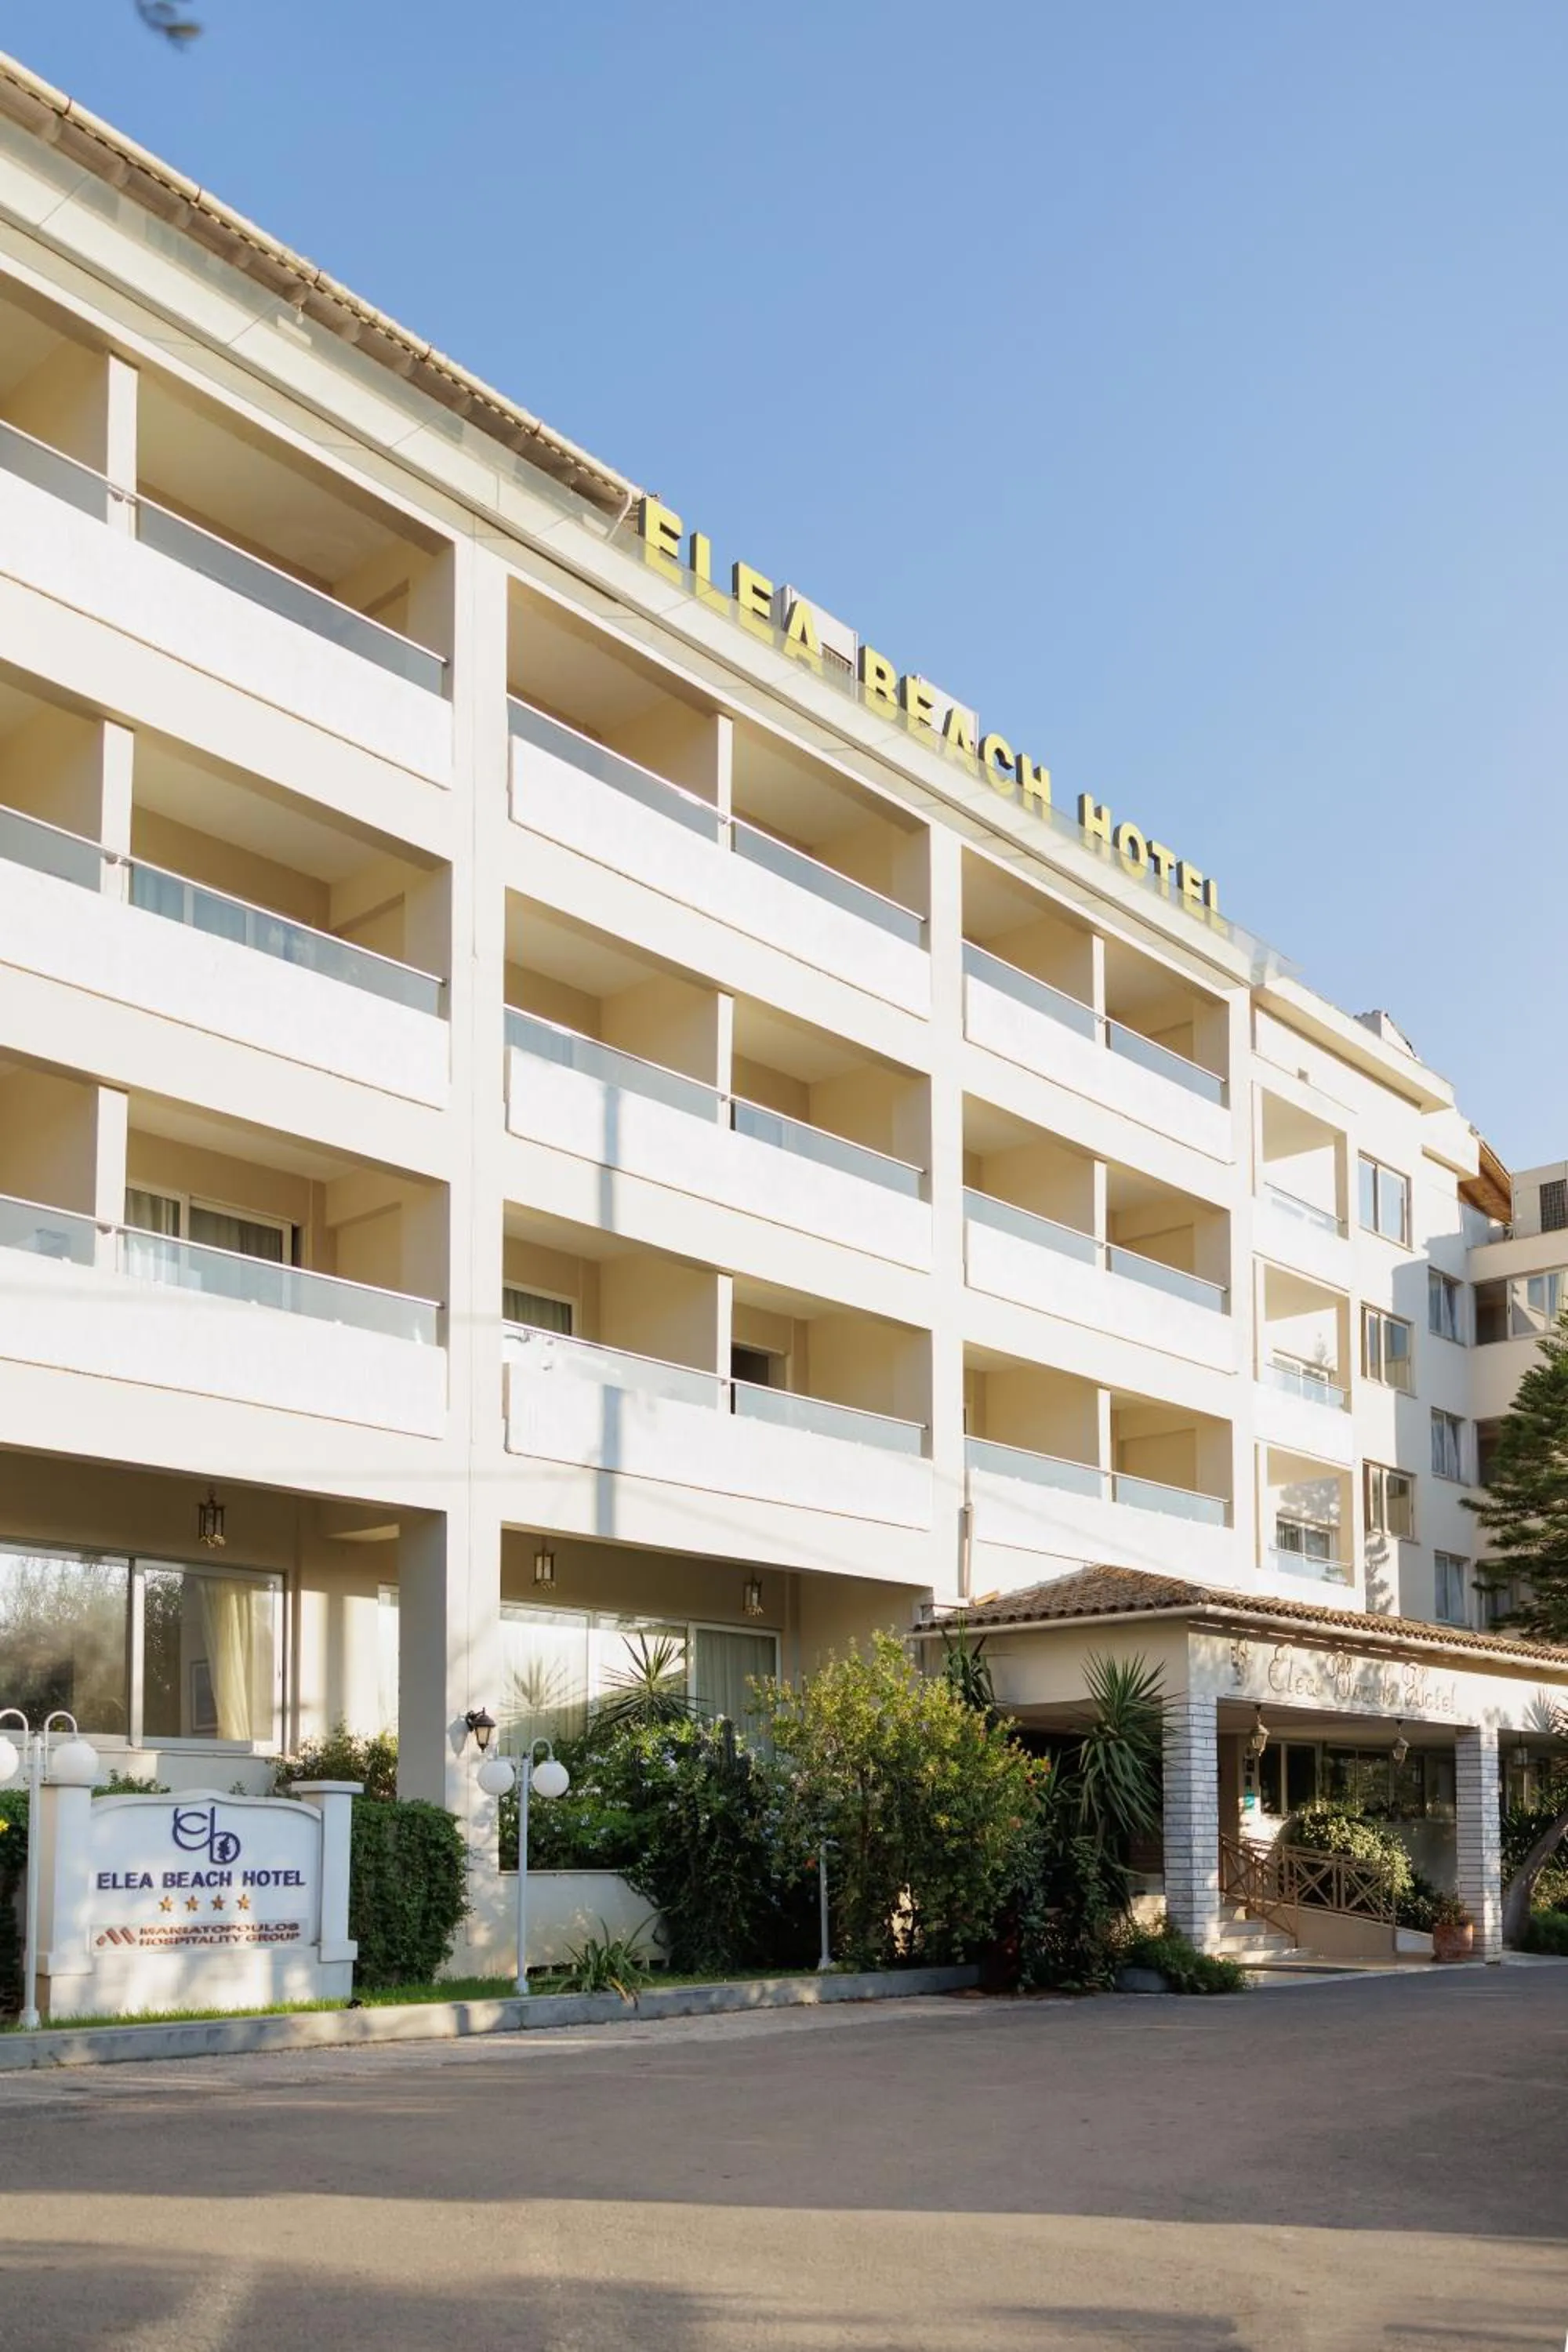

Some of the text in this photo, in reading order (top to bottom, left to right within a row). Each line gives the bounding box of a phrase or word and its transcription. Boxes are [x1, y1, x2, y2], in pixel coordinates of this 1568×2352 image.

[638, 495, 1229, 938] ELEA BEACH HOTEL
[96, 1870, 307, 1890] ELEA BEACH HOTEL
[139, 1922, 300, 1936] MANIATOPOULOS
[139, 1932, 301, 1947] HOSPITALITY GROUP
